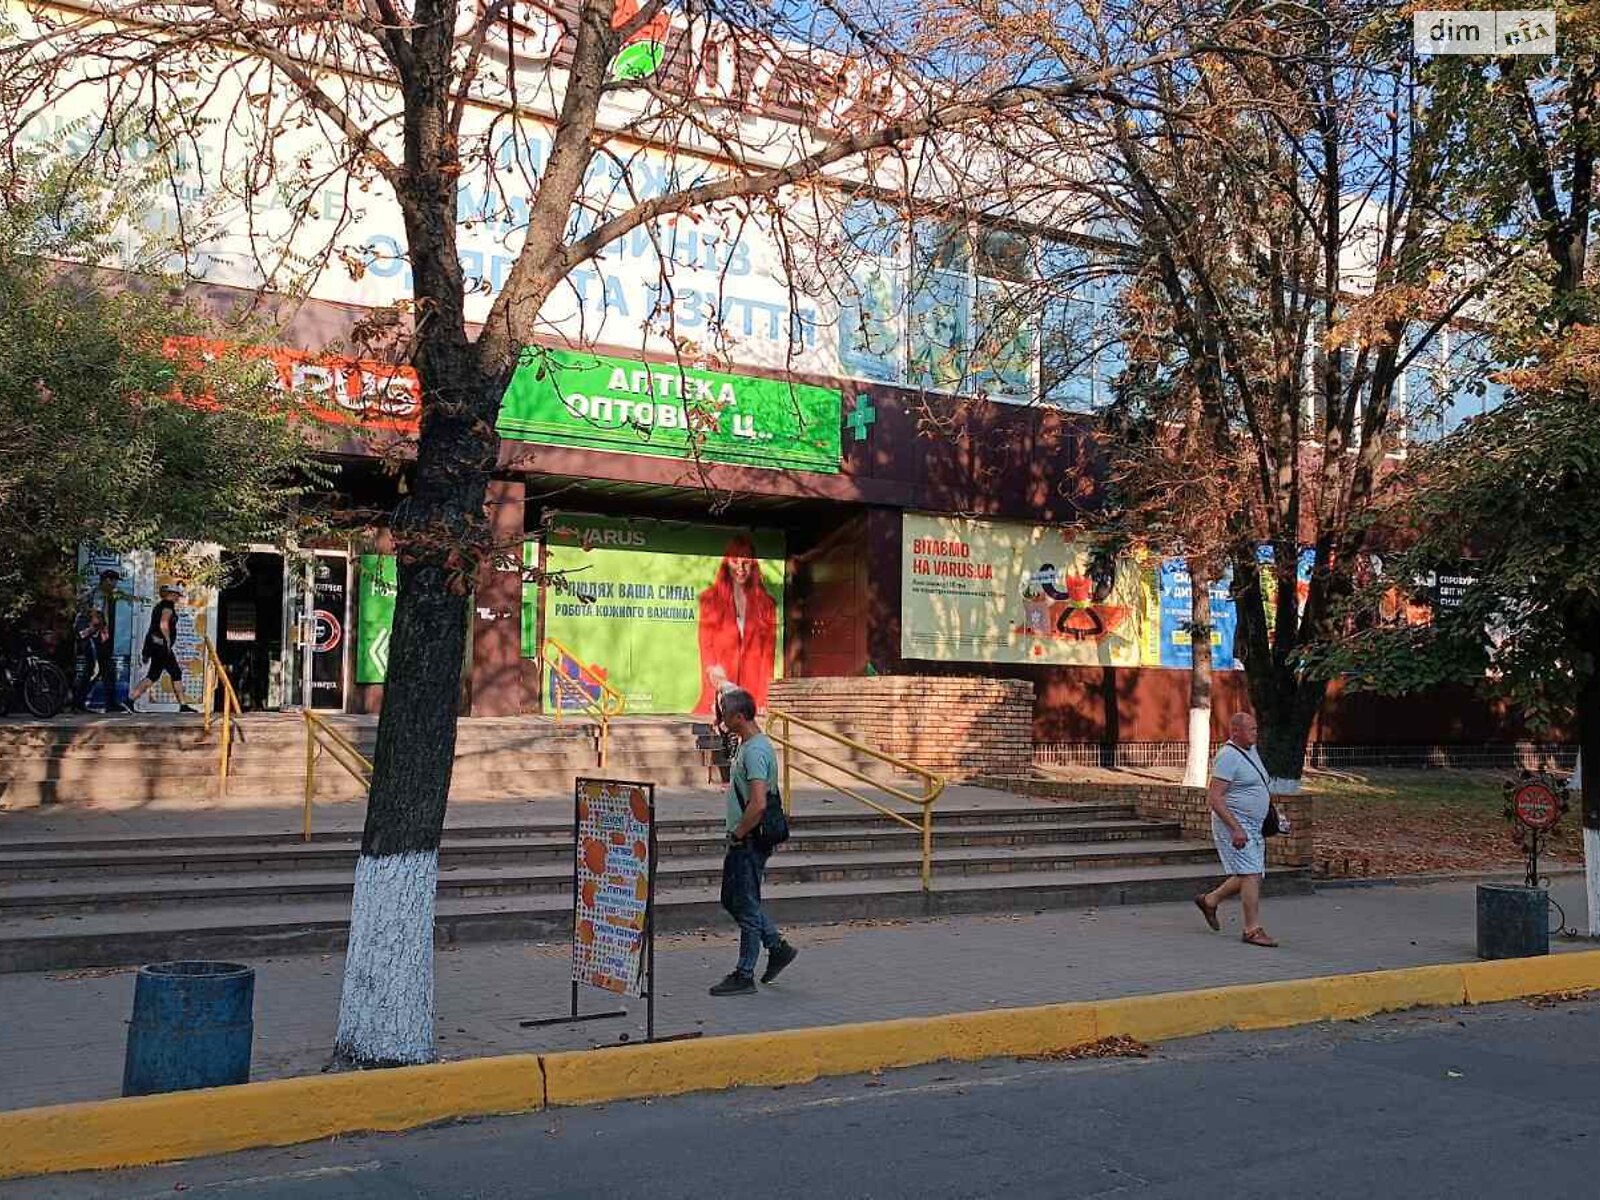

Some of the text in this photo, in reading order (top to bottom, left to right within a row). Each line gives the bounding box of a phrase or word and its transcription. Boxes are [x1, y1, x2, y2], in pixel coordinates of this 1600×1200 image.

[571, 269, 630, 317] ТА
[608, 367, 737, 406] АПТЕКА
[913, 538, 970, 558] ВІТАЄМО
[912, 559, 993, 580] НА VARUS.UA
[568, 582, 614, 599] ЛЮДЯХ
[619, 583, 654, 600] ВАША
[659, 585, 695, 601] СИЛА!
[555, 604, 592, 617] РОБОТА
[596, 605, 643, 619] КОЖНОГО
